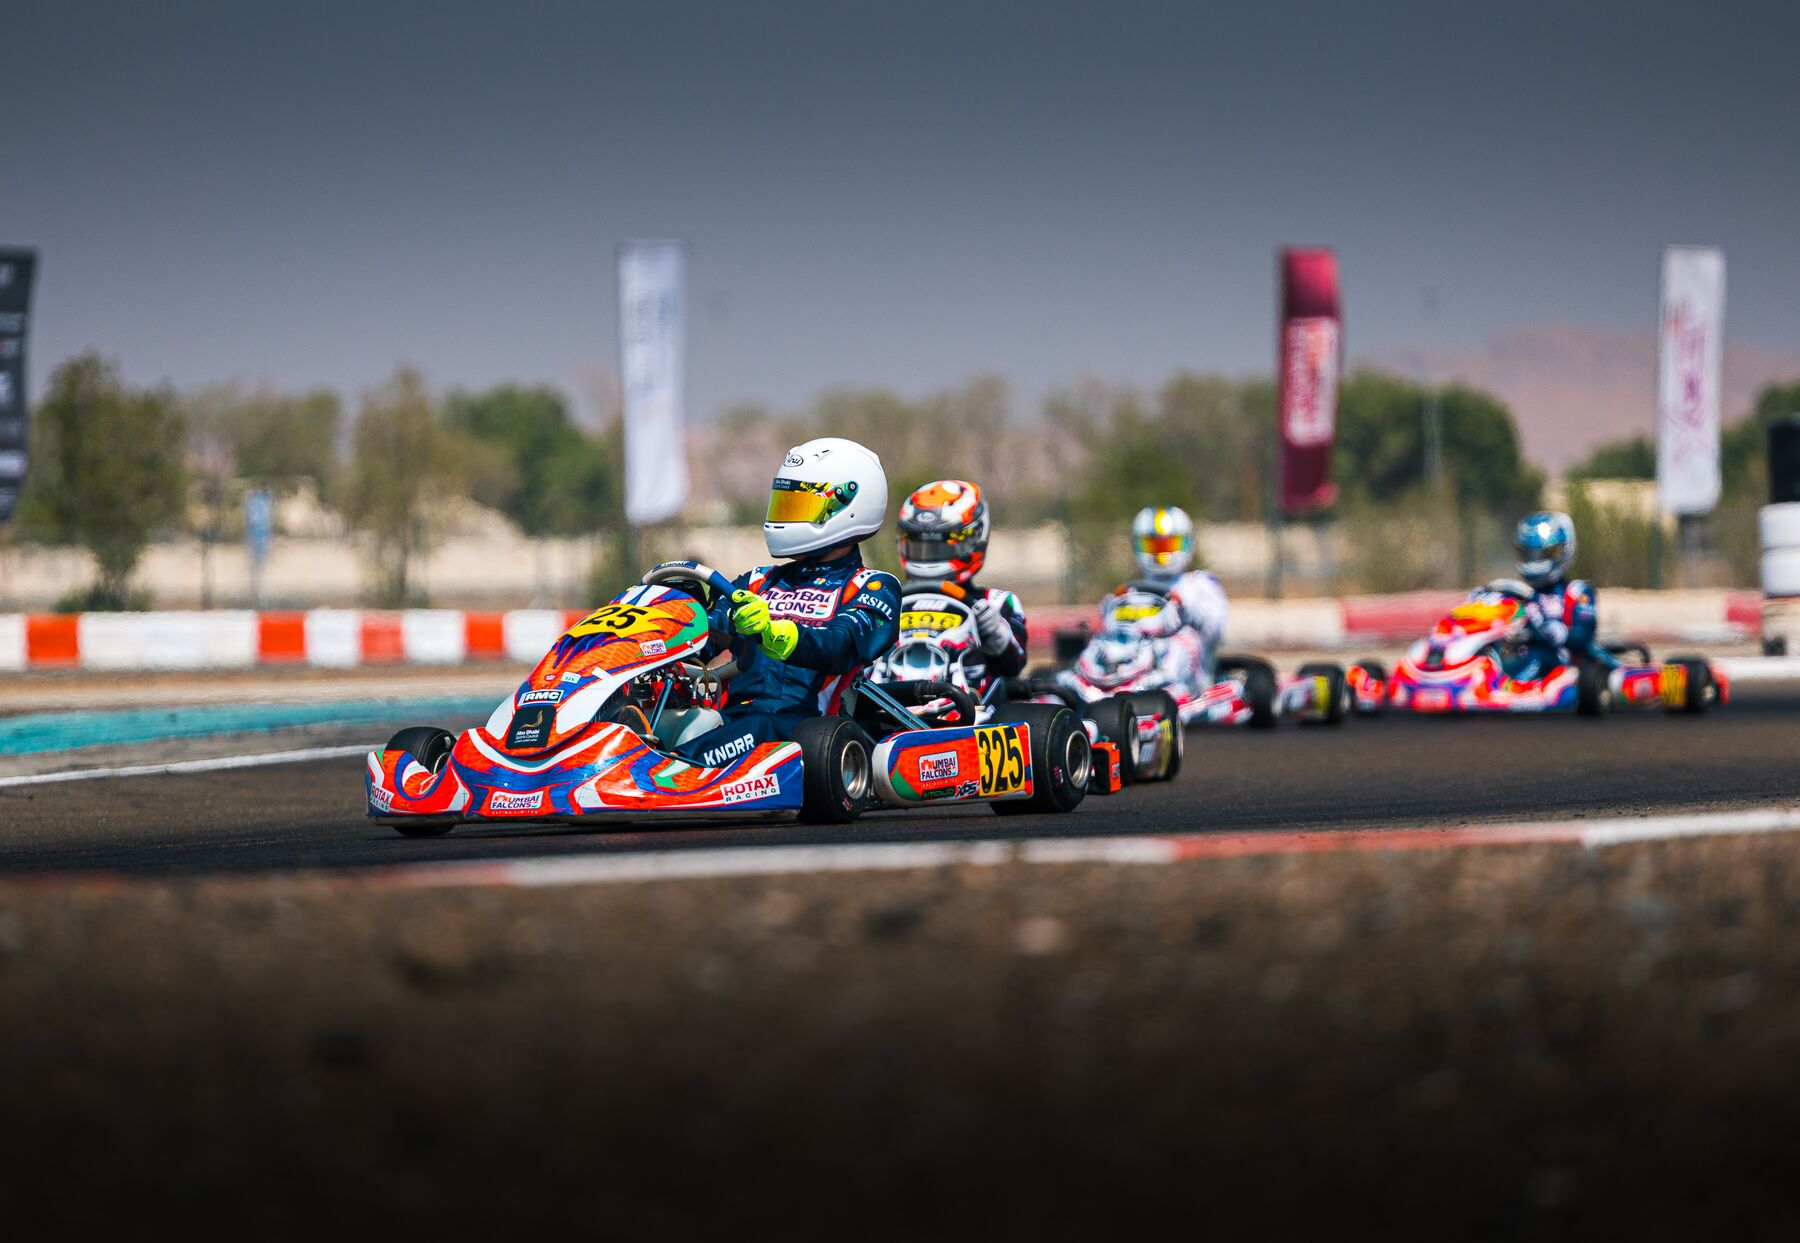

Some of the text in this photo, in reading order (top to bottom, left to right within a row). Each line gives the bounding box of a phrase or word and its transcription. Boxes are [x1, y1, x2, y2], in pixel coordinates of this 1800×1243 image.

[580, 607, 649, 629] 25
[526, 691, 559, 701] RMC
[703, 733, 755, 766] KNORR
[979, 727, 1023, 794] 325
[922, 768, 952, 780] FALCONS
[372, 784, 391, 804] ROTAX
[723, 777, 775, 796] ROTAX
[725, 789, 777, 802] RACING
